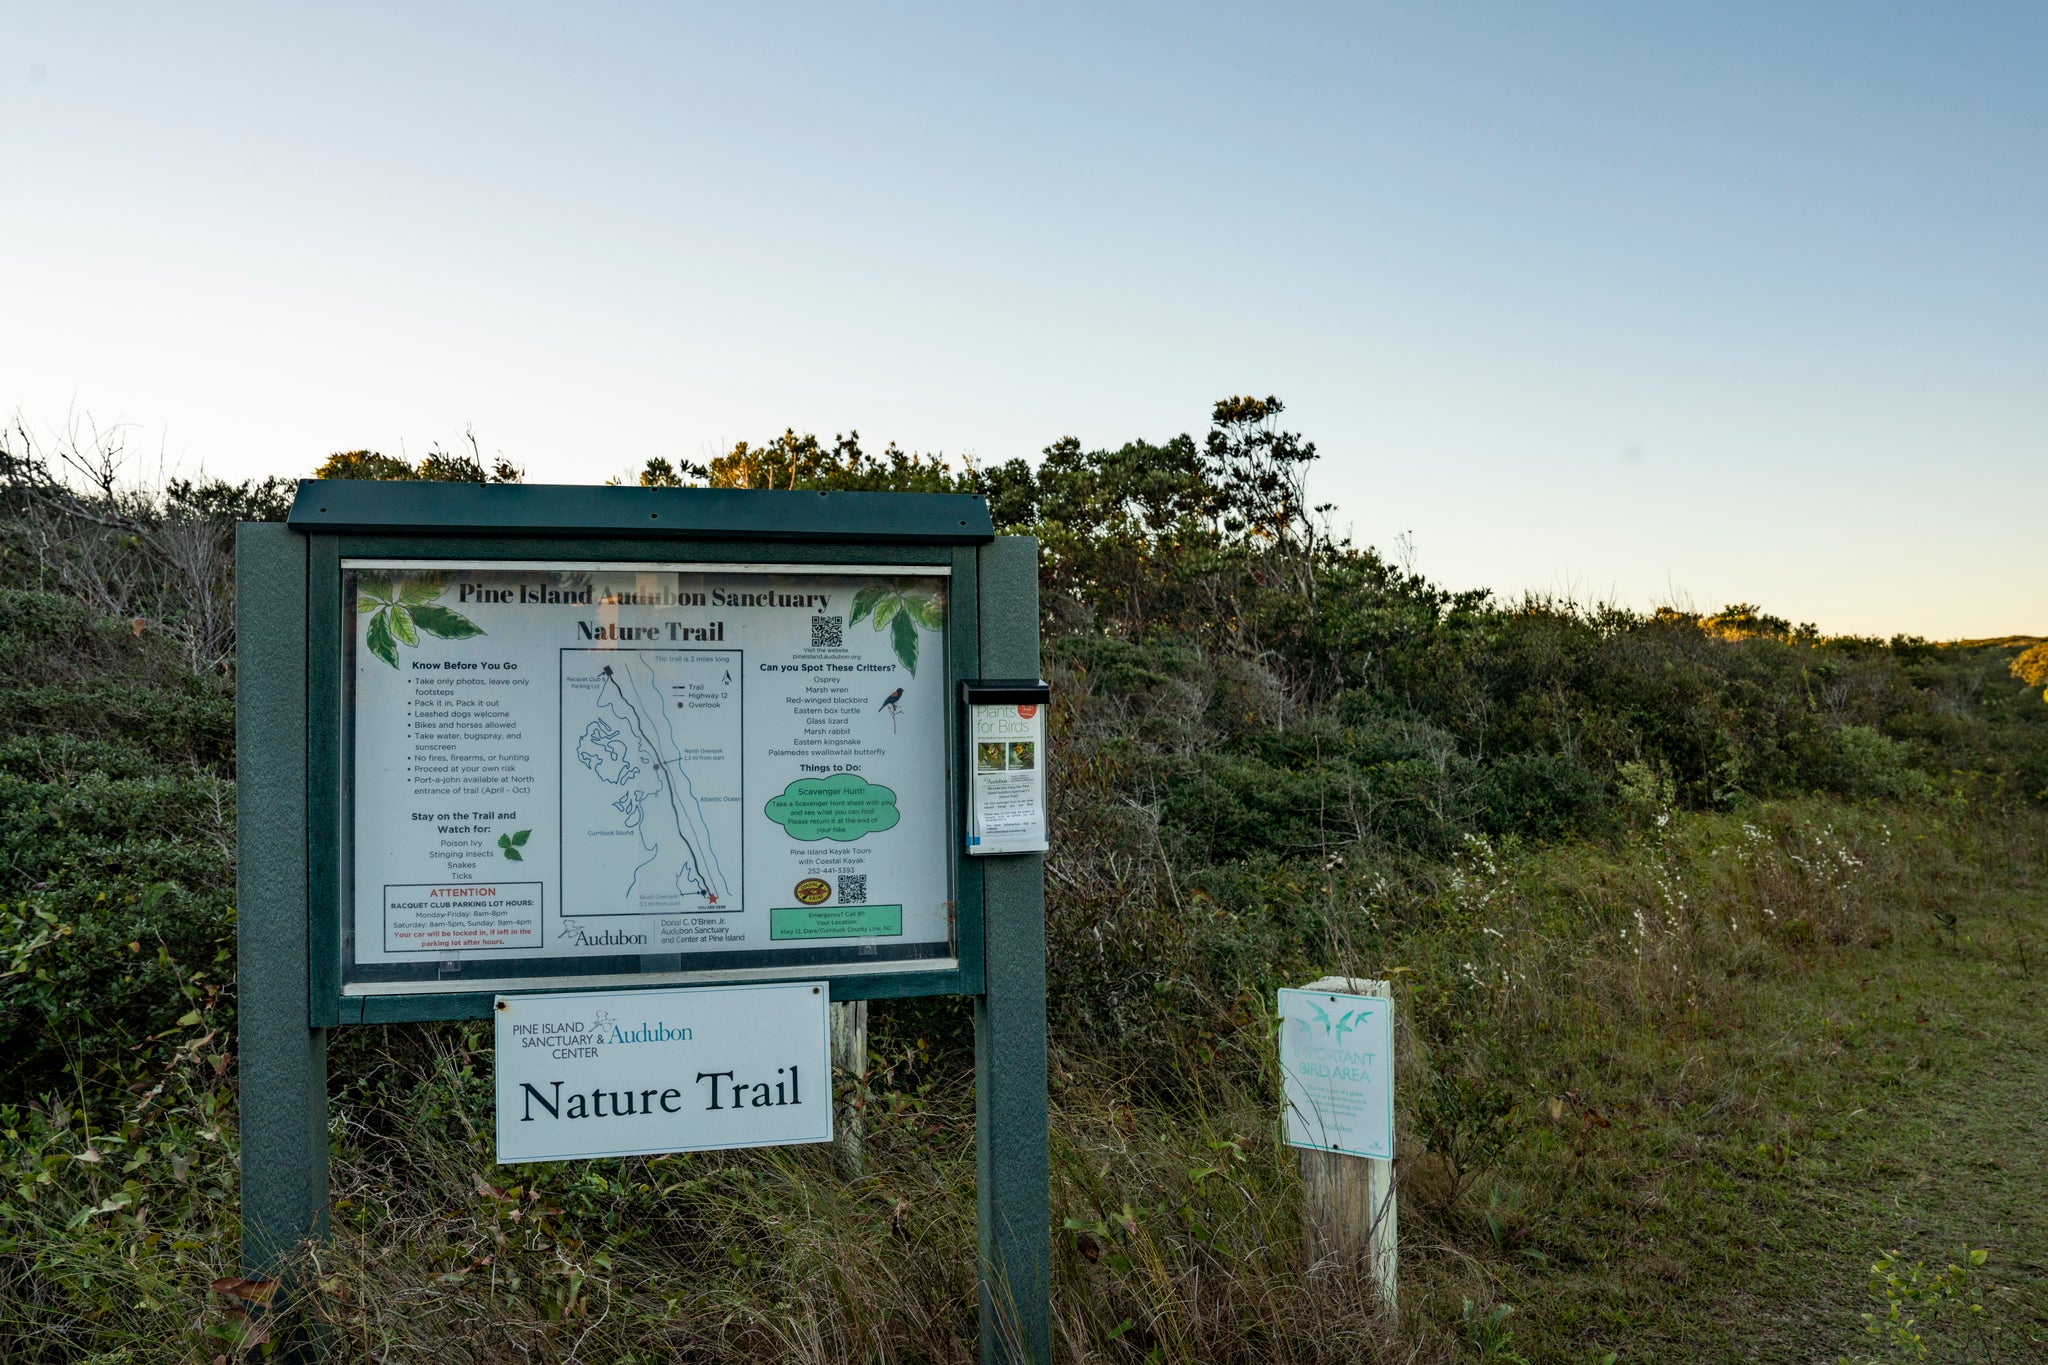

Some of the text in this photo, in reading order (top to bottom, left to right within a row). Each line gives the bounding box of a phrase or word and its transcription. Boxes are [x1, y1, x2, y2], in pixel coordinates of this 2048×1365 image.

[458, 583, 831, 613] Pine Island Audubon Sanctuary
[577, 620, 725, 641] Nature Trail
[412, 662, 518, 670] Know Before You Go
[801, 664, 823, 672] Spot
[437, 678, 454, 686] only
[456, 678, 487, 686] photos,
[512, 678, 530, 686] only
[688, 692, 719, 700] Highway
[445, 700, 454, 708] in,
[786, 697, 831, 705] Red-winged
[451, 711, 471, 719] dogs
[978, 704, 1016, 718] Plants
[978, 720, 1029, 733] for Birds
[854, 748, 885, 756] butterfly
[451, 754, 486, 762] firearms,
[499, 754, 530, 762] hunting
[800, 764, 830, 772] Things
[798, 788, 841, 796] Scavenger
[412, 813, 433, 821] Stay
[453, 812, 469, 820] the
[474, 825, 491, 833] for:
[430, 851, 463, 859] Stinging
[430, 888, 496, 897] ATTENTION
[574, 930, 647, 946] Audubon
[513, 1022, 584, 1035] PINE ISLAND
[608, 1022, 692, 1044] Audubon
[522, 1035, 604, 1048] SANCTUARY &
[552, 1048, 599, 1059] CENTER
[1299, 1062, 1371, 1083] BIRD AREA
[519, 1065, 802, 1122] Nature Trail
